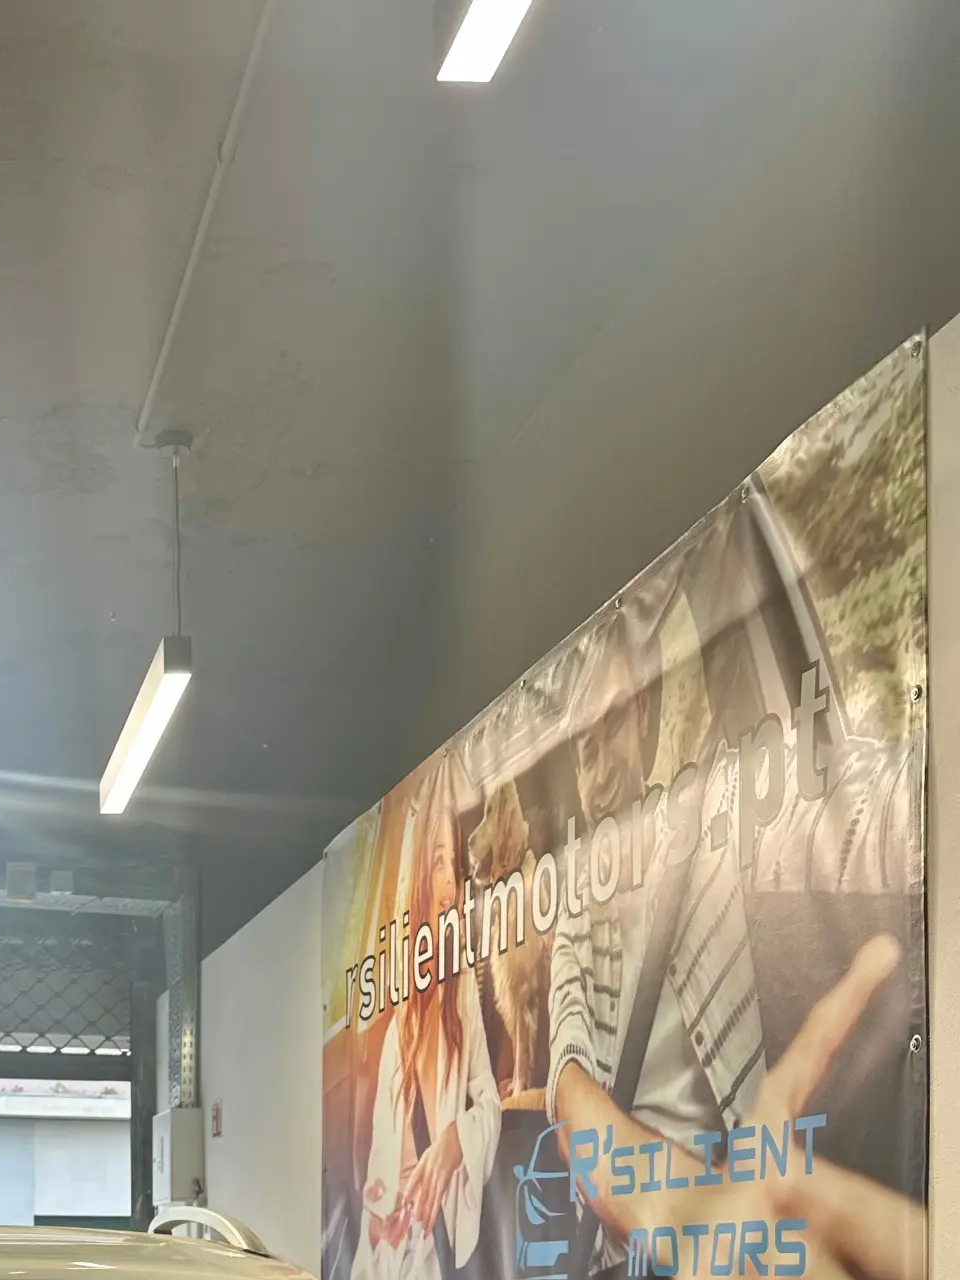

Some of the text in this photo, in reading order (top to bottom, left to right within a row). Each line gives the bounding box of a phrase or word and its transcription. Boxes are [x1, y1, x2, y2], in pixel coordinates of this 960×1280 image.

[345, 660, 829, 1029] rsilientmotors.pt
[569, 1113, 827, 1202] R'SILIENT
[627, 1218, 808, 1278] MOTORS
